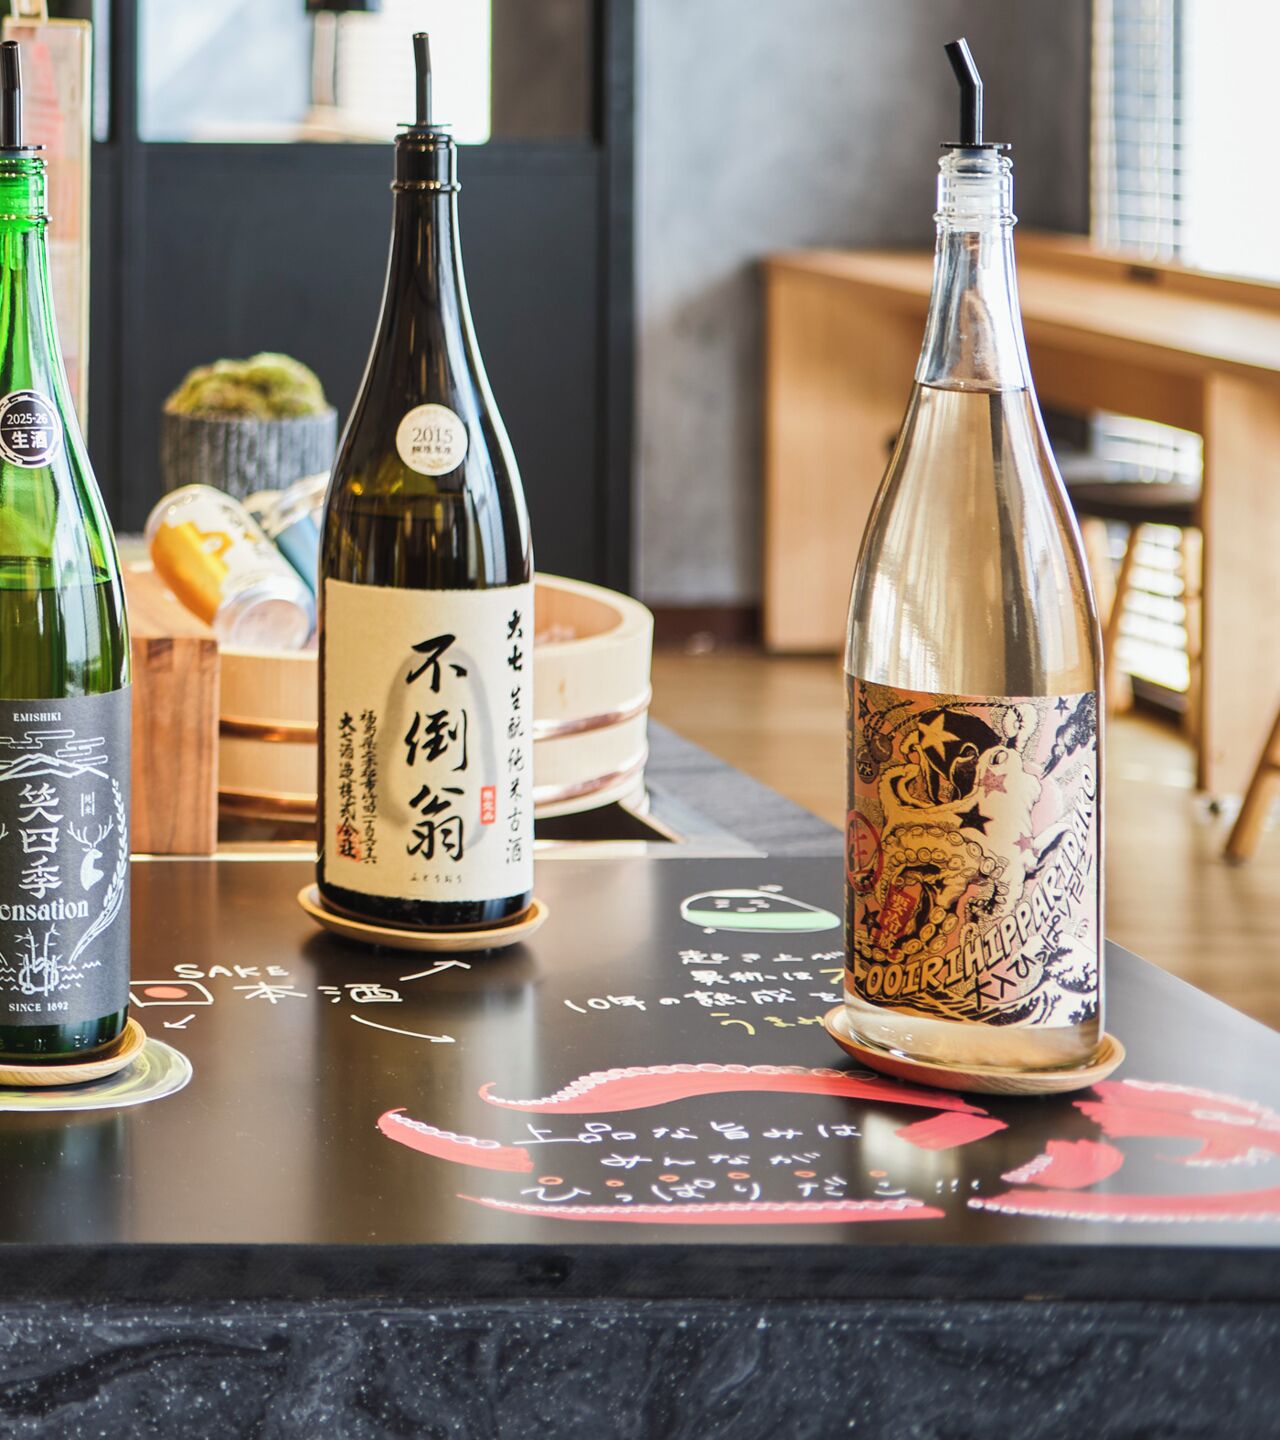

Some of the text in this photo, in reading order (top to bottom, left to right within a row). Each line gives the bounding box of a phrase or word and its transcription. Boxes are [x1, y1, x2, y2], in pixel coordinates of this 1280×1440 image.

[6, 413, 49, 425] 2025-26
[11, 430, 48, 449] 生酒
[412, 426, 454, 443] 2015
[12, 711, 62, 723] EMISHIKI
[406, 633, 469, 862] 不倒翁
[17, 781, 65, 899] 笑四季
[173, 963, 291, 979] SAKE
[8, 1001, 70, 1013] SINCE 1892
[513, 1121, 862, 1146] 上品な旨みは
[599, 1152, 822, 1169] みんなが
